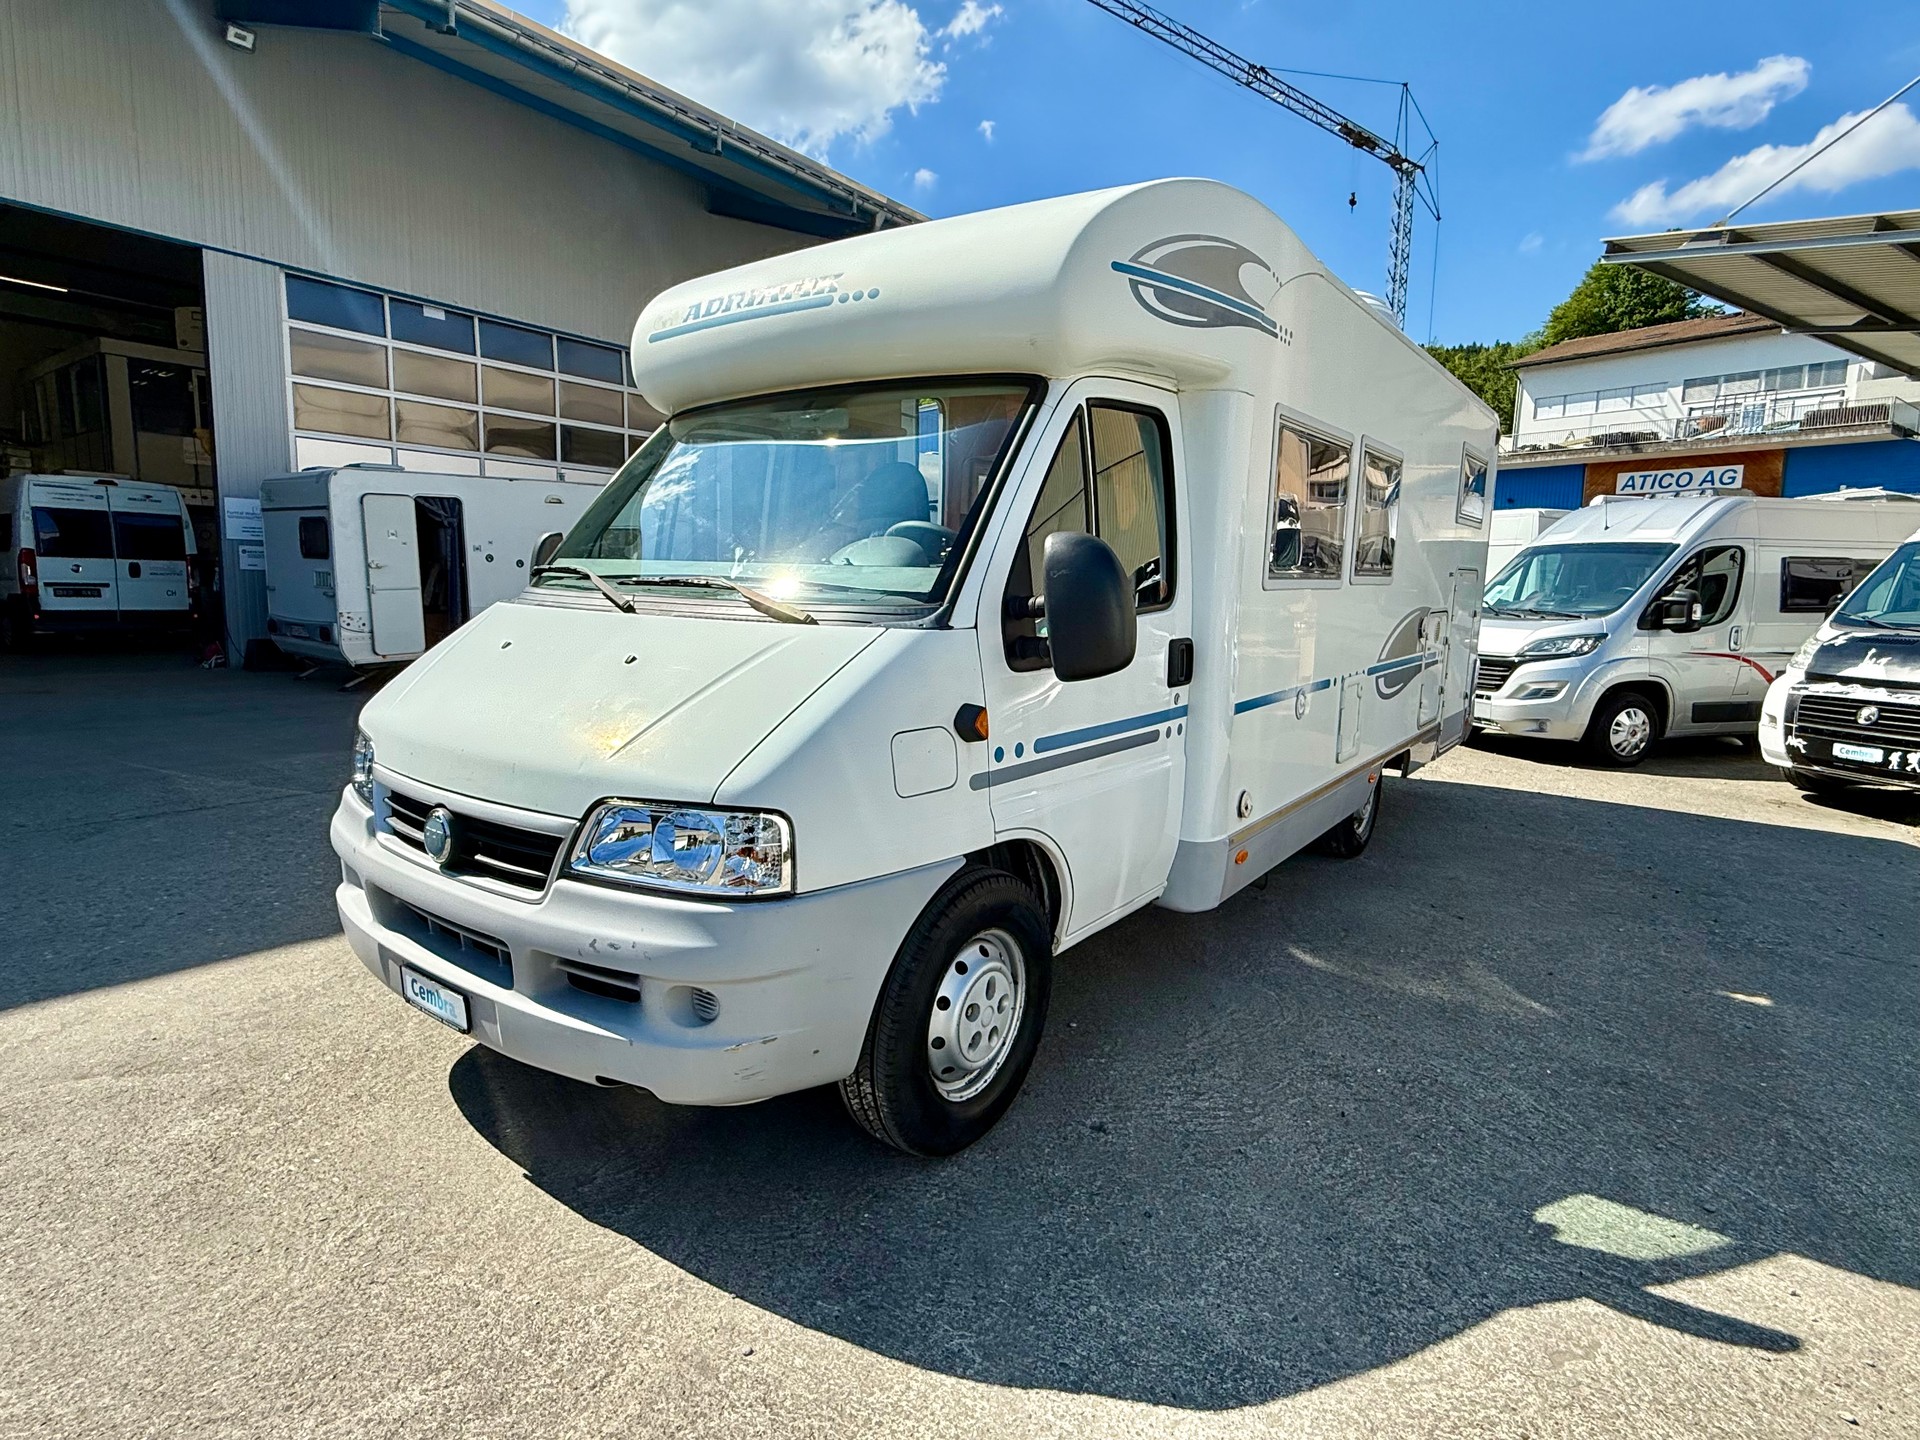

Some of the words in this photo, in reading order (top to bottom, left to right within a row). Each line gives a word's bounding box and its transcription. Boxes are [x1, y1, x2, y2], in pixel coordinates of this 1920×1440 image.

[1620, 471, 1694, 491] ATICO
[1698, 468, 1738, 487] AG
[166, 589, 177, 597] CH
[411, 978, 457, 1019] Cembra
